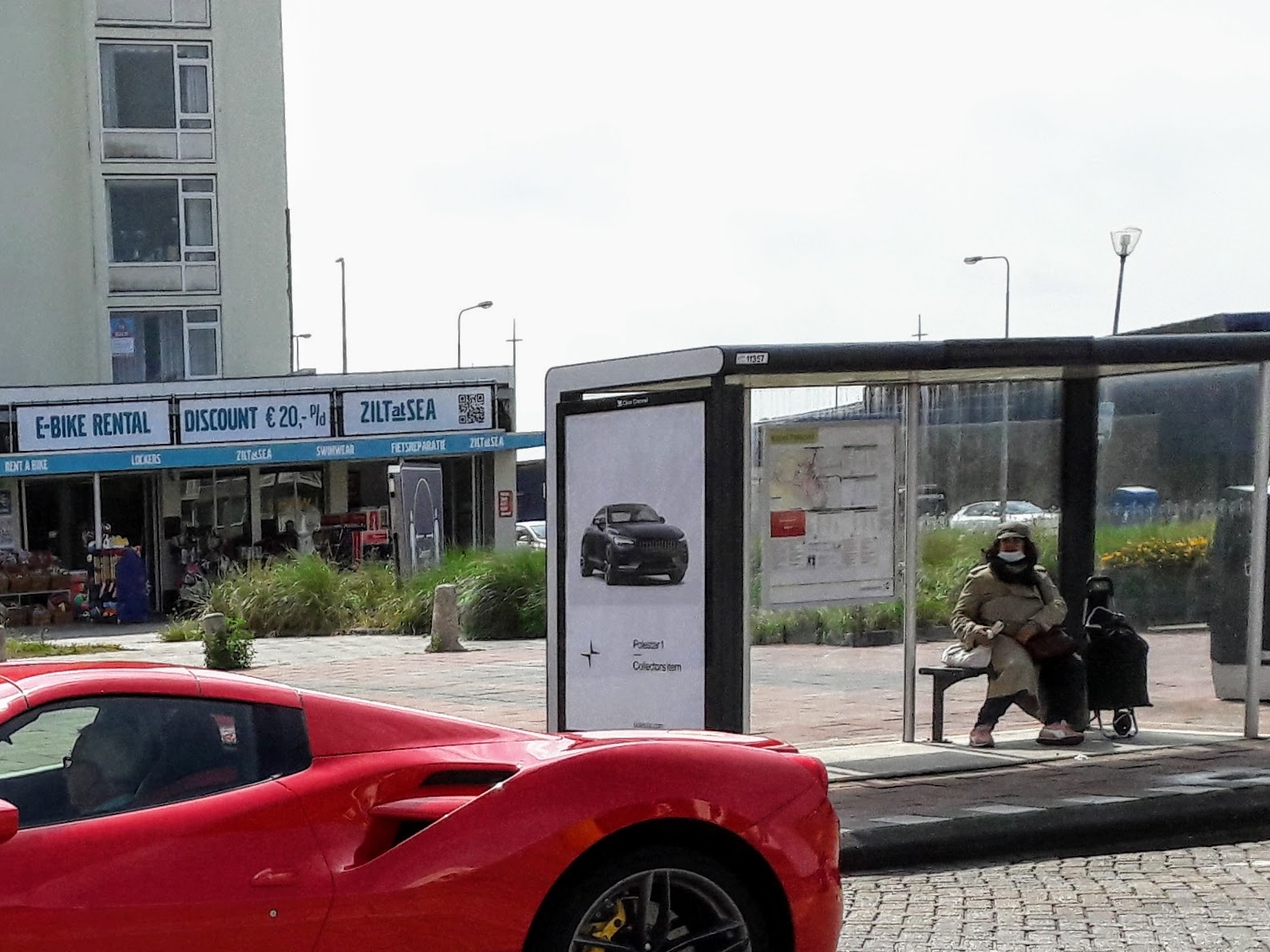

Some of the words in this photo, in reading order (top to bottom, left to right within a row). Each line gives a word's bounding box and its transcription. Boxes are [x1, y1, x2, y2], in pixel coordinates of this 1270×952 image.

[36, 414, 87, 439] E-BIKE
[92, 411, 151, 436] RENTAL
[184, 406, 259, 432] DISCOUNT
[5, 461, 23, 472] RENT
[25, 460, 30, 471] A
[32, 459, 48, 471] BIKE
[131, 454, 162, 466] LOCKERS
